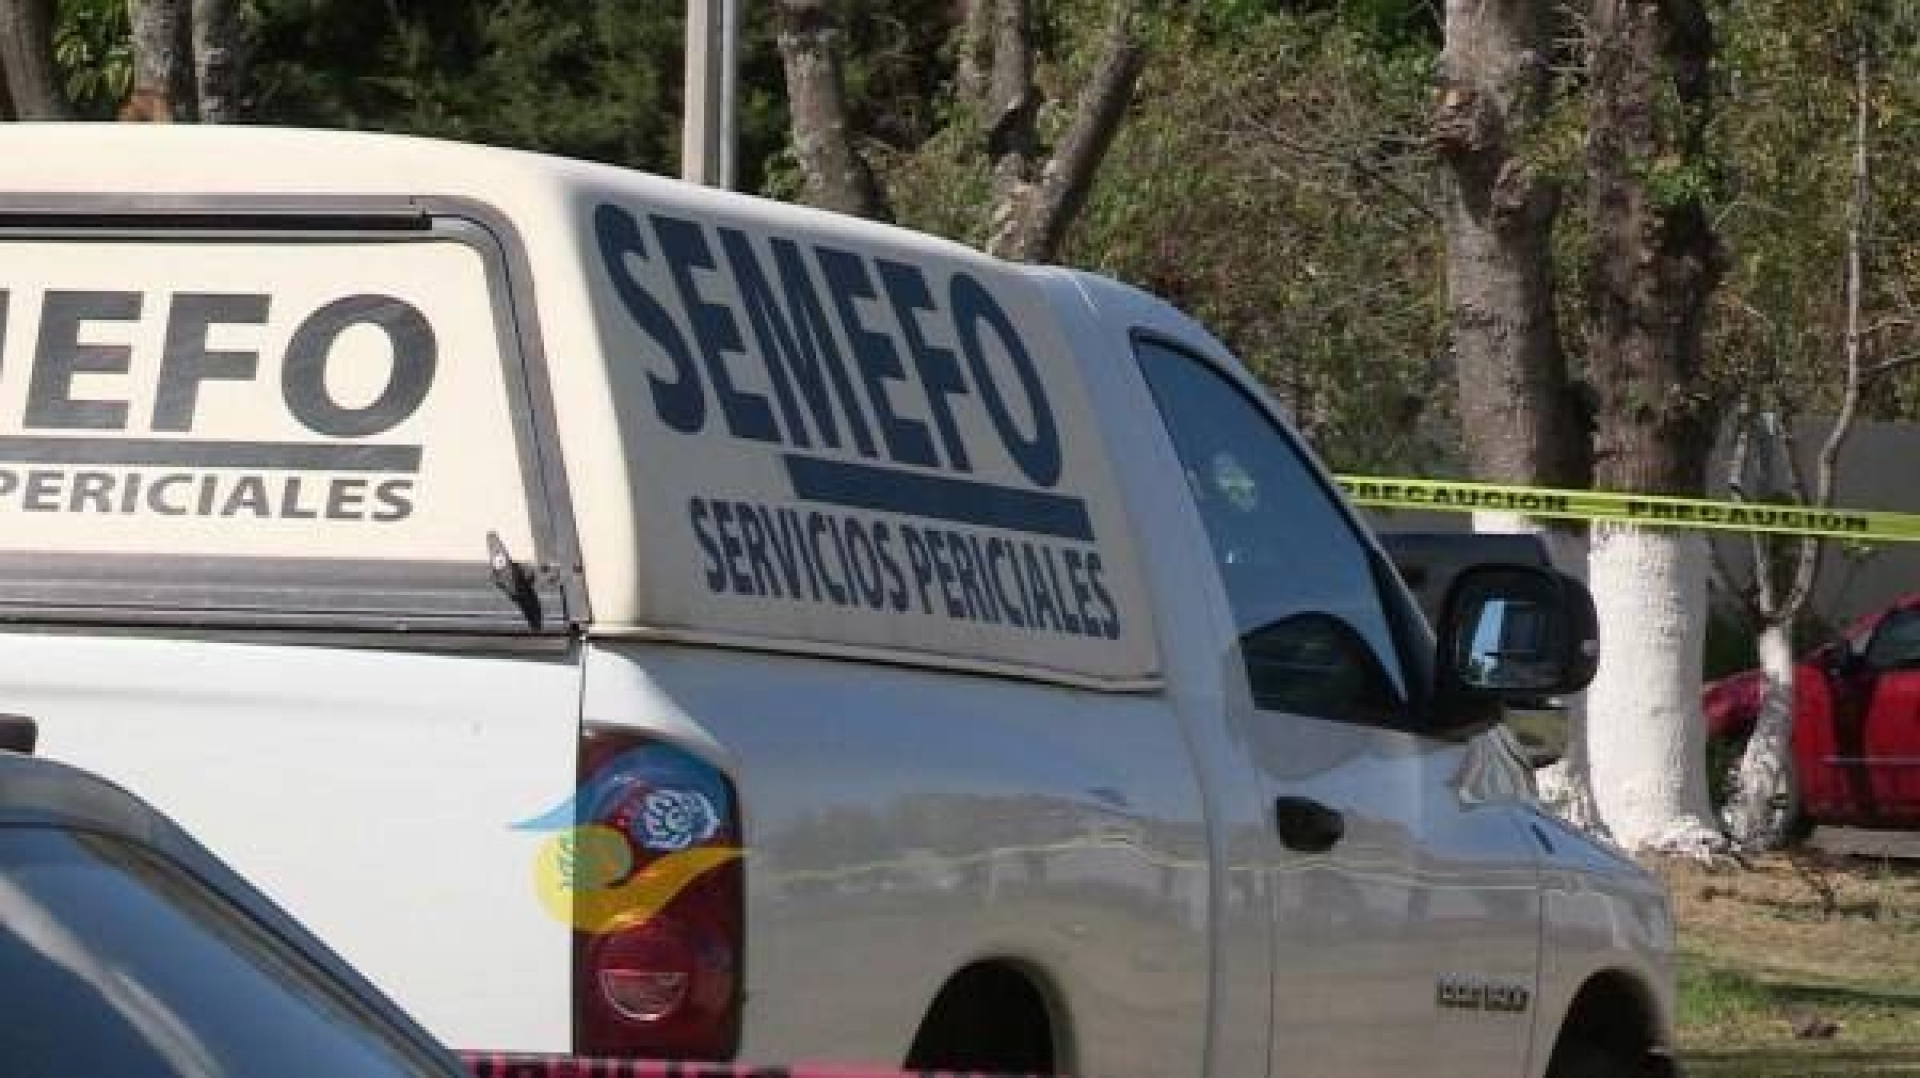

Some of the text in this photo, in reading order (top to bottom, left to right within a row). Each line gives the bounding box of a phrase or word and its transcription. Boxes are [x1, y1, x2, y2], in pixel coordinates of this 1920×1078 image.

[0, 288, 438, 438] EFO
[595, 204, 1062, 487] SEMEFO
[690, 495, 1120, 641] SERVICIOS PERICIALES
